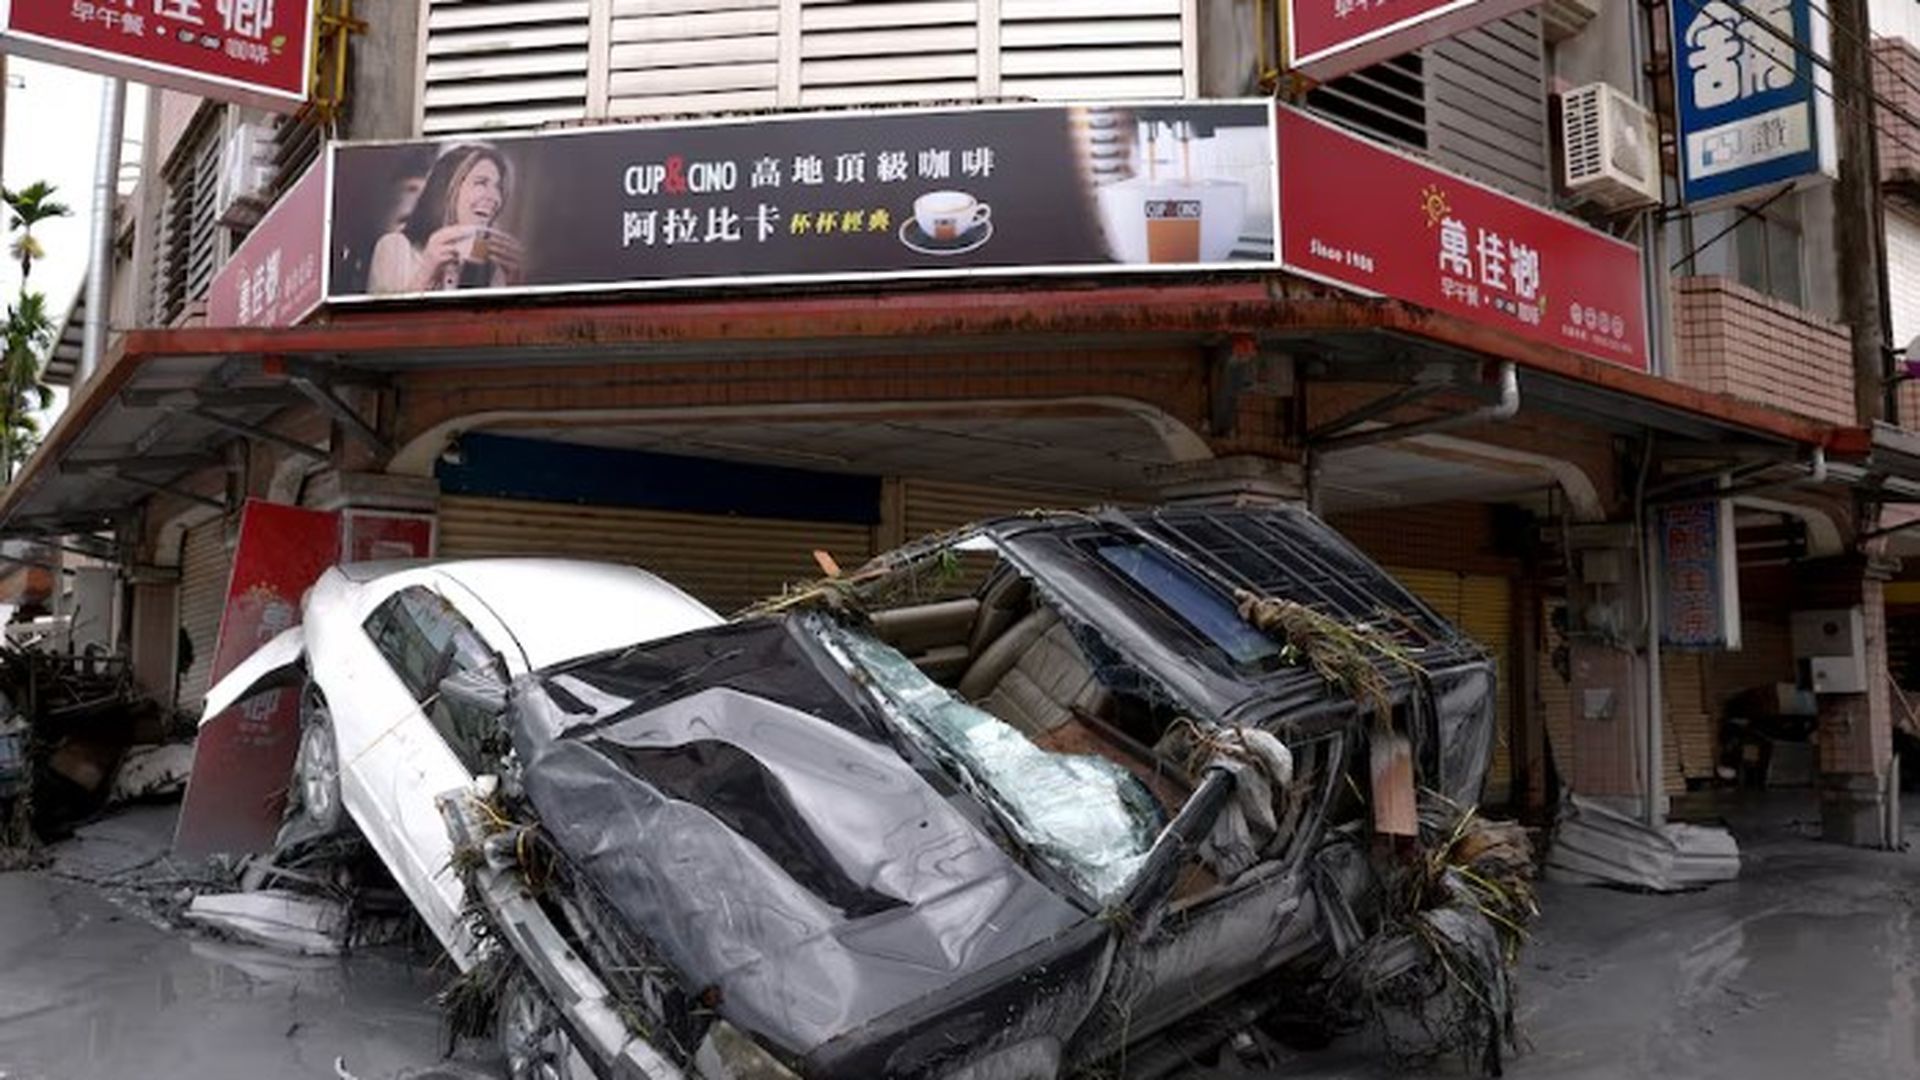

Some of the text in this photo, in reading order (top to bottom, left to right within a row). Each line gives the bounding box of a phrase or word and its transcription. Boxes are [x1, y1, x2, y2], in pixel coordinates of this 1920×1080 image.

[71, 1, 144, 36] 早午餐
[624, 147, 995, 195] CUP&CINO 高地頂級咖啡
[623, 204, 780, 247] 阿拉比卡
